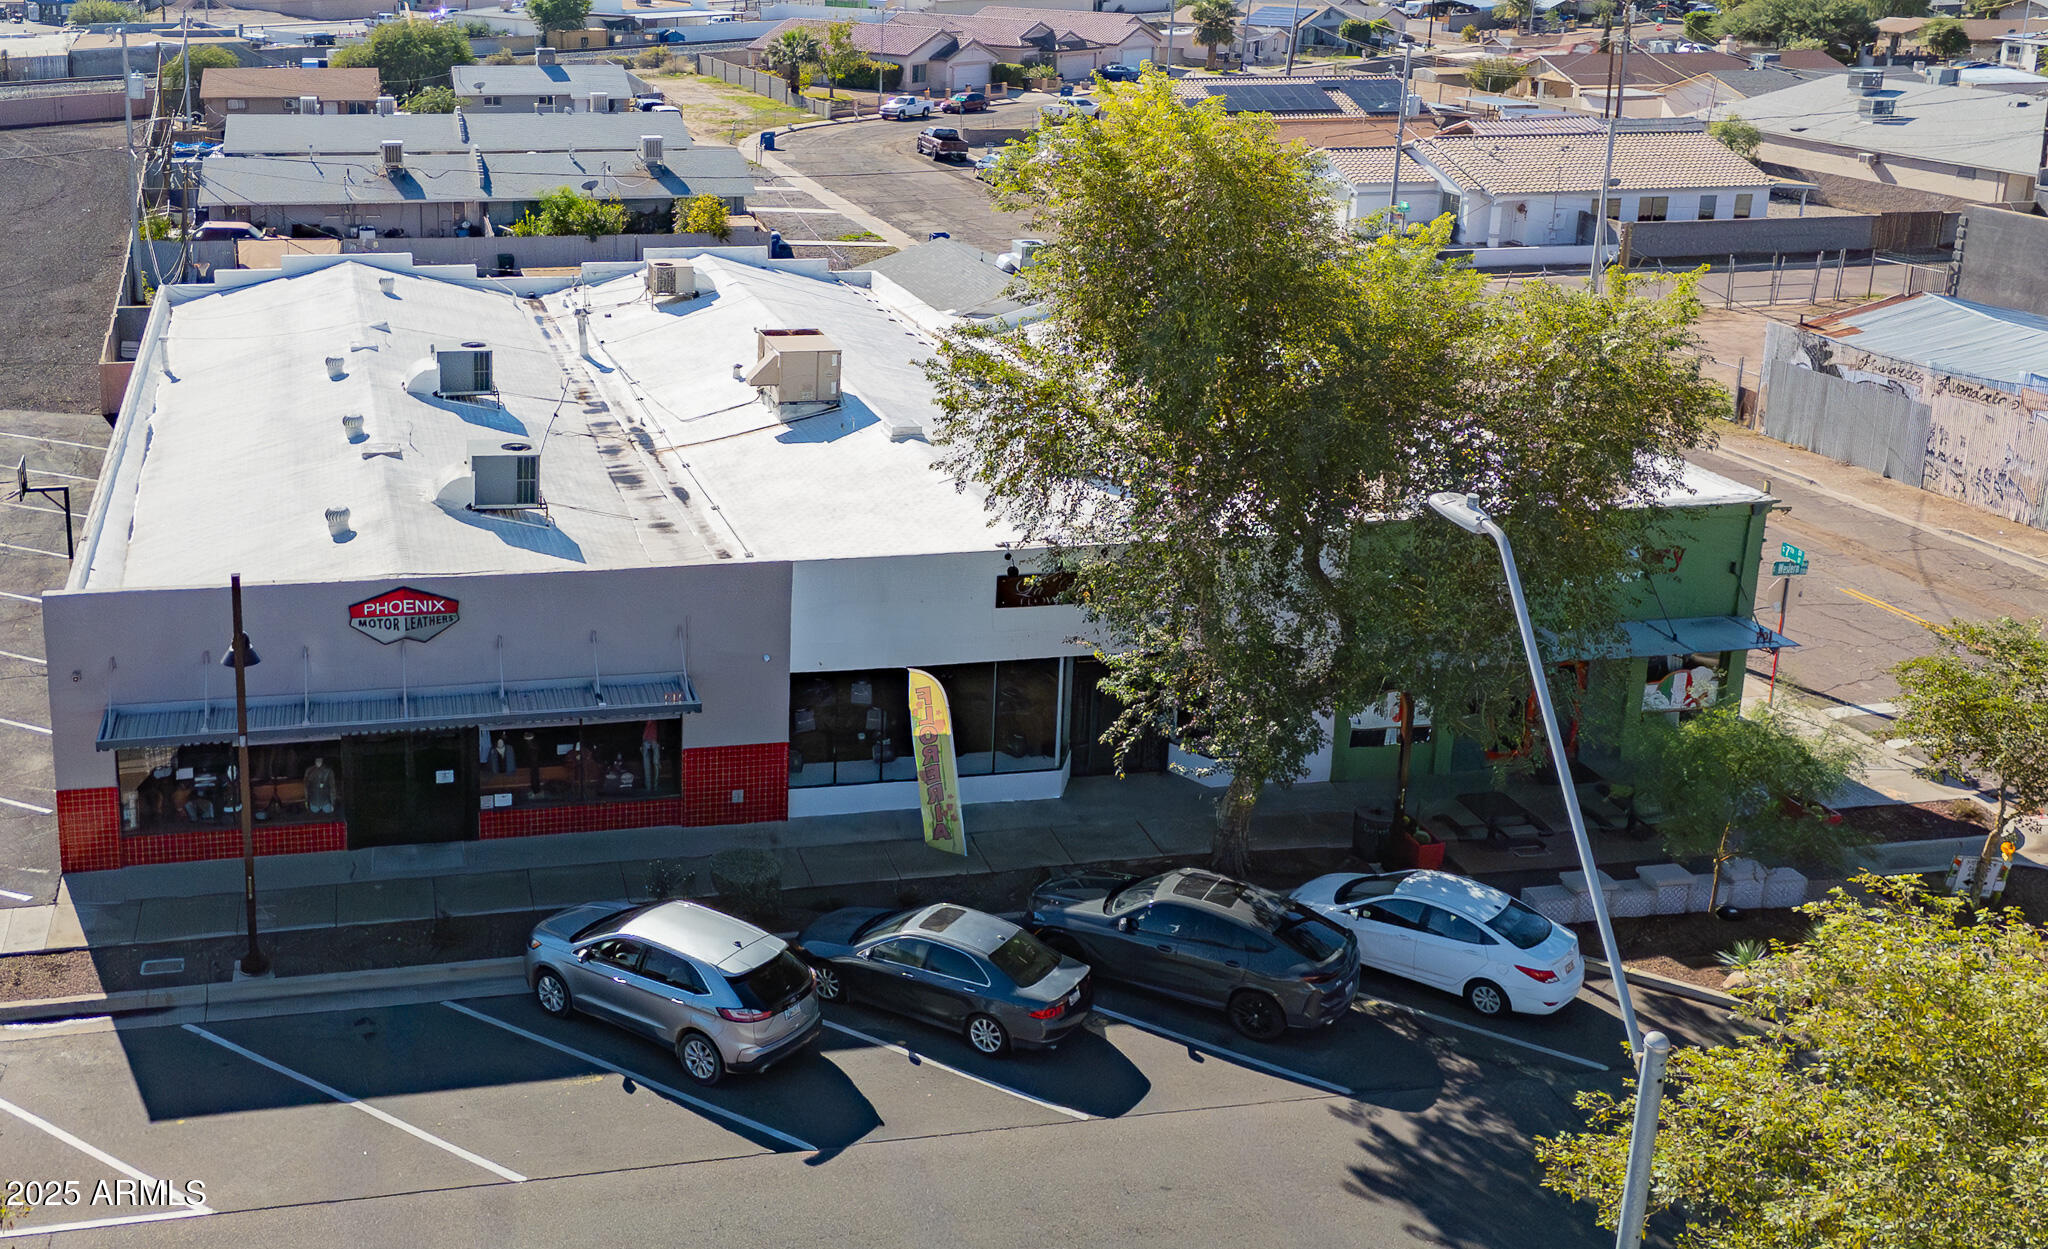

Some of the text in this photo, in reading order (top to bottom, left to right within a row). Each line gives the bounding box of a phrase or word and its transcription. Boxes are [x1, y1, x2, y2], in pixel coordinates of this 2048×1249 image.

[363, 599, 446, 615] PHOENIX
[358, 614, 454, 632] MOTOR LEATHERS
